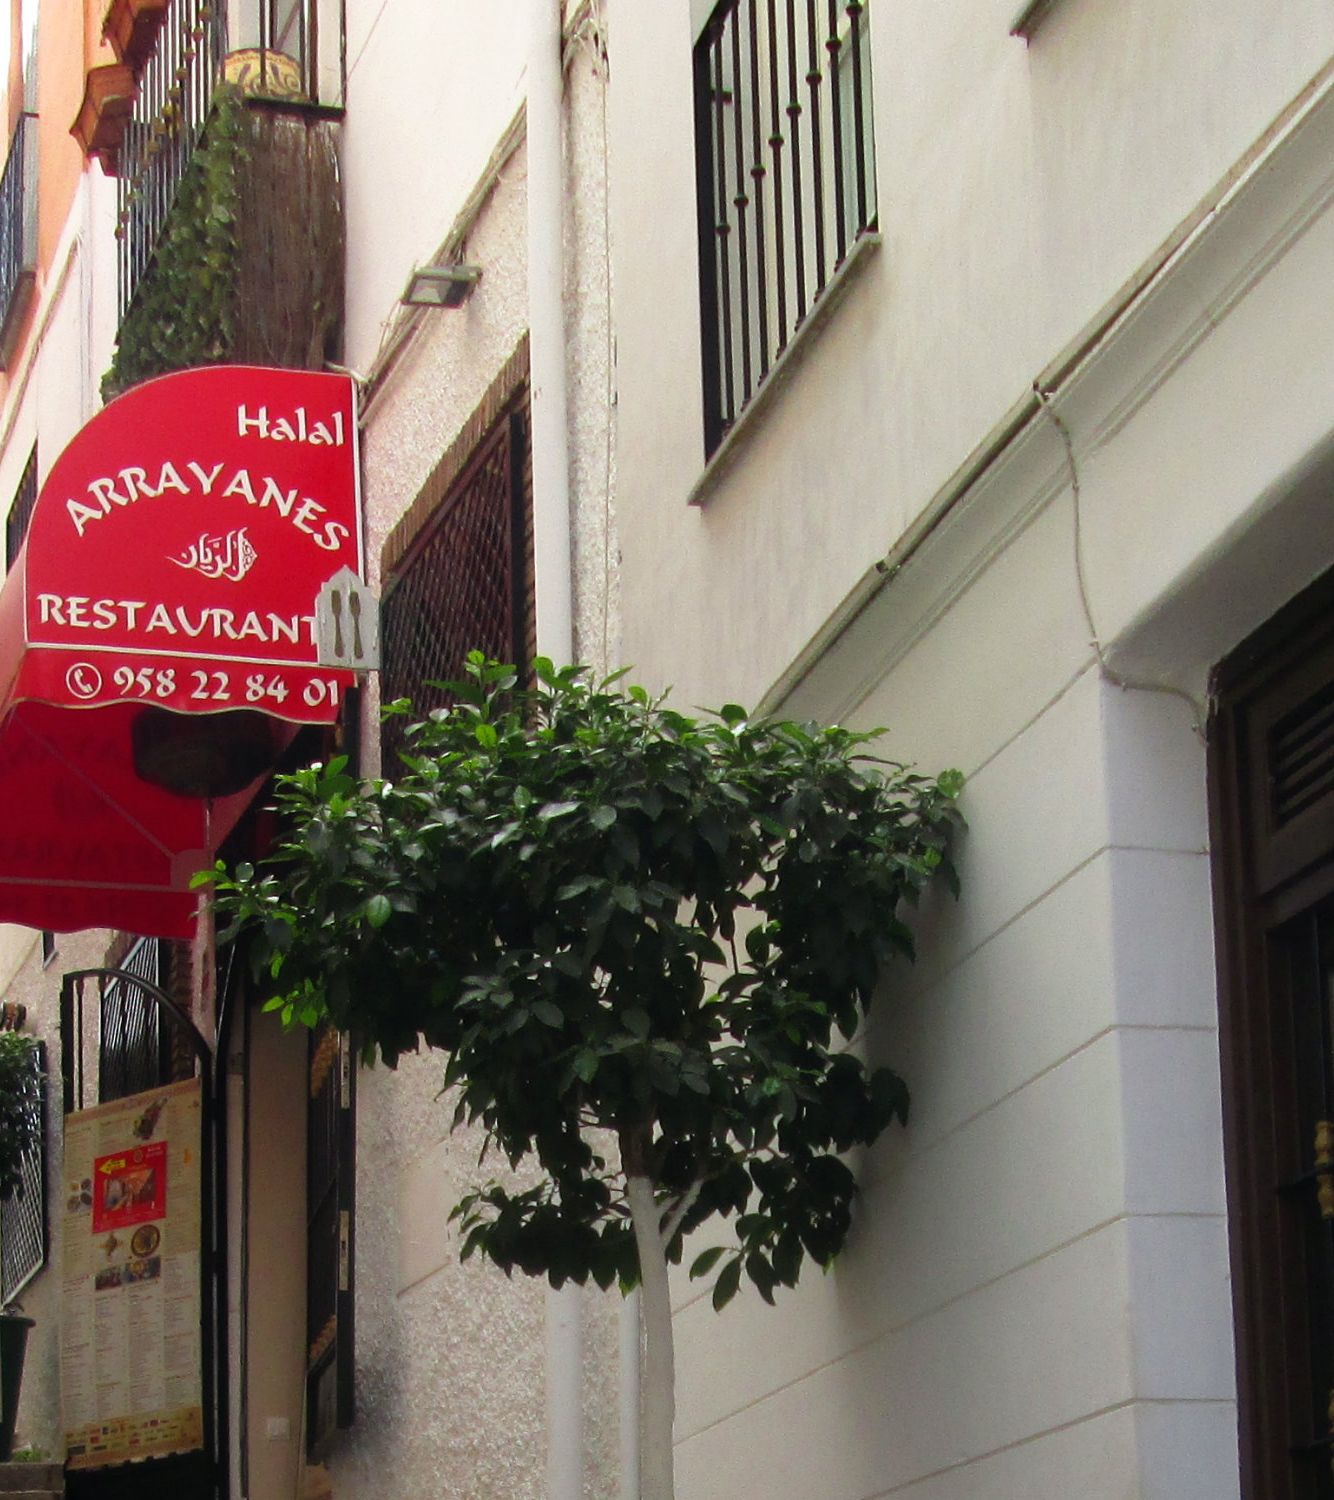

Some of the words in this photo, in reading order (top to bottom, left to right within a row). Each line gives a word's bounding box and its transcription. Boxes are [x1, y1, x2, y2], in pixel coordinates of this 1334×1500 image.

[237, 403, 346, 447] Halal
[65, 460, 351, 552] ARRAYANES
[36, 593, 318, 645] RESTAURANT
[113, 665, 177, 699] 958
[190, 669, 232, 700] 22
[244, 673, 290, 705] 84
[302, 678, 340, 708] 01
